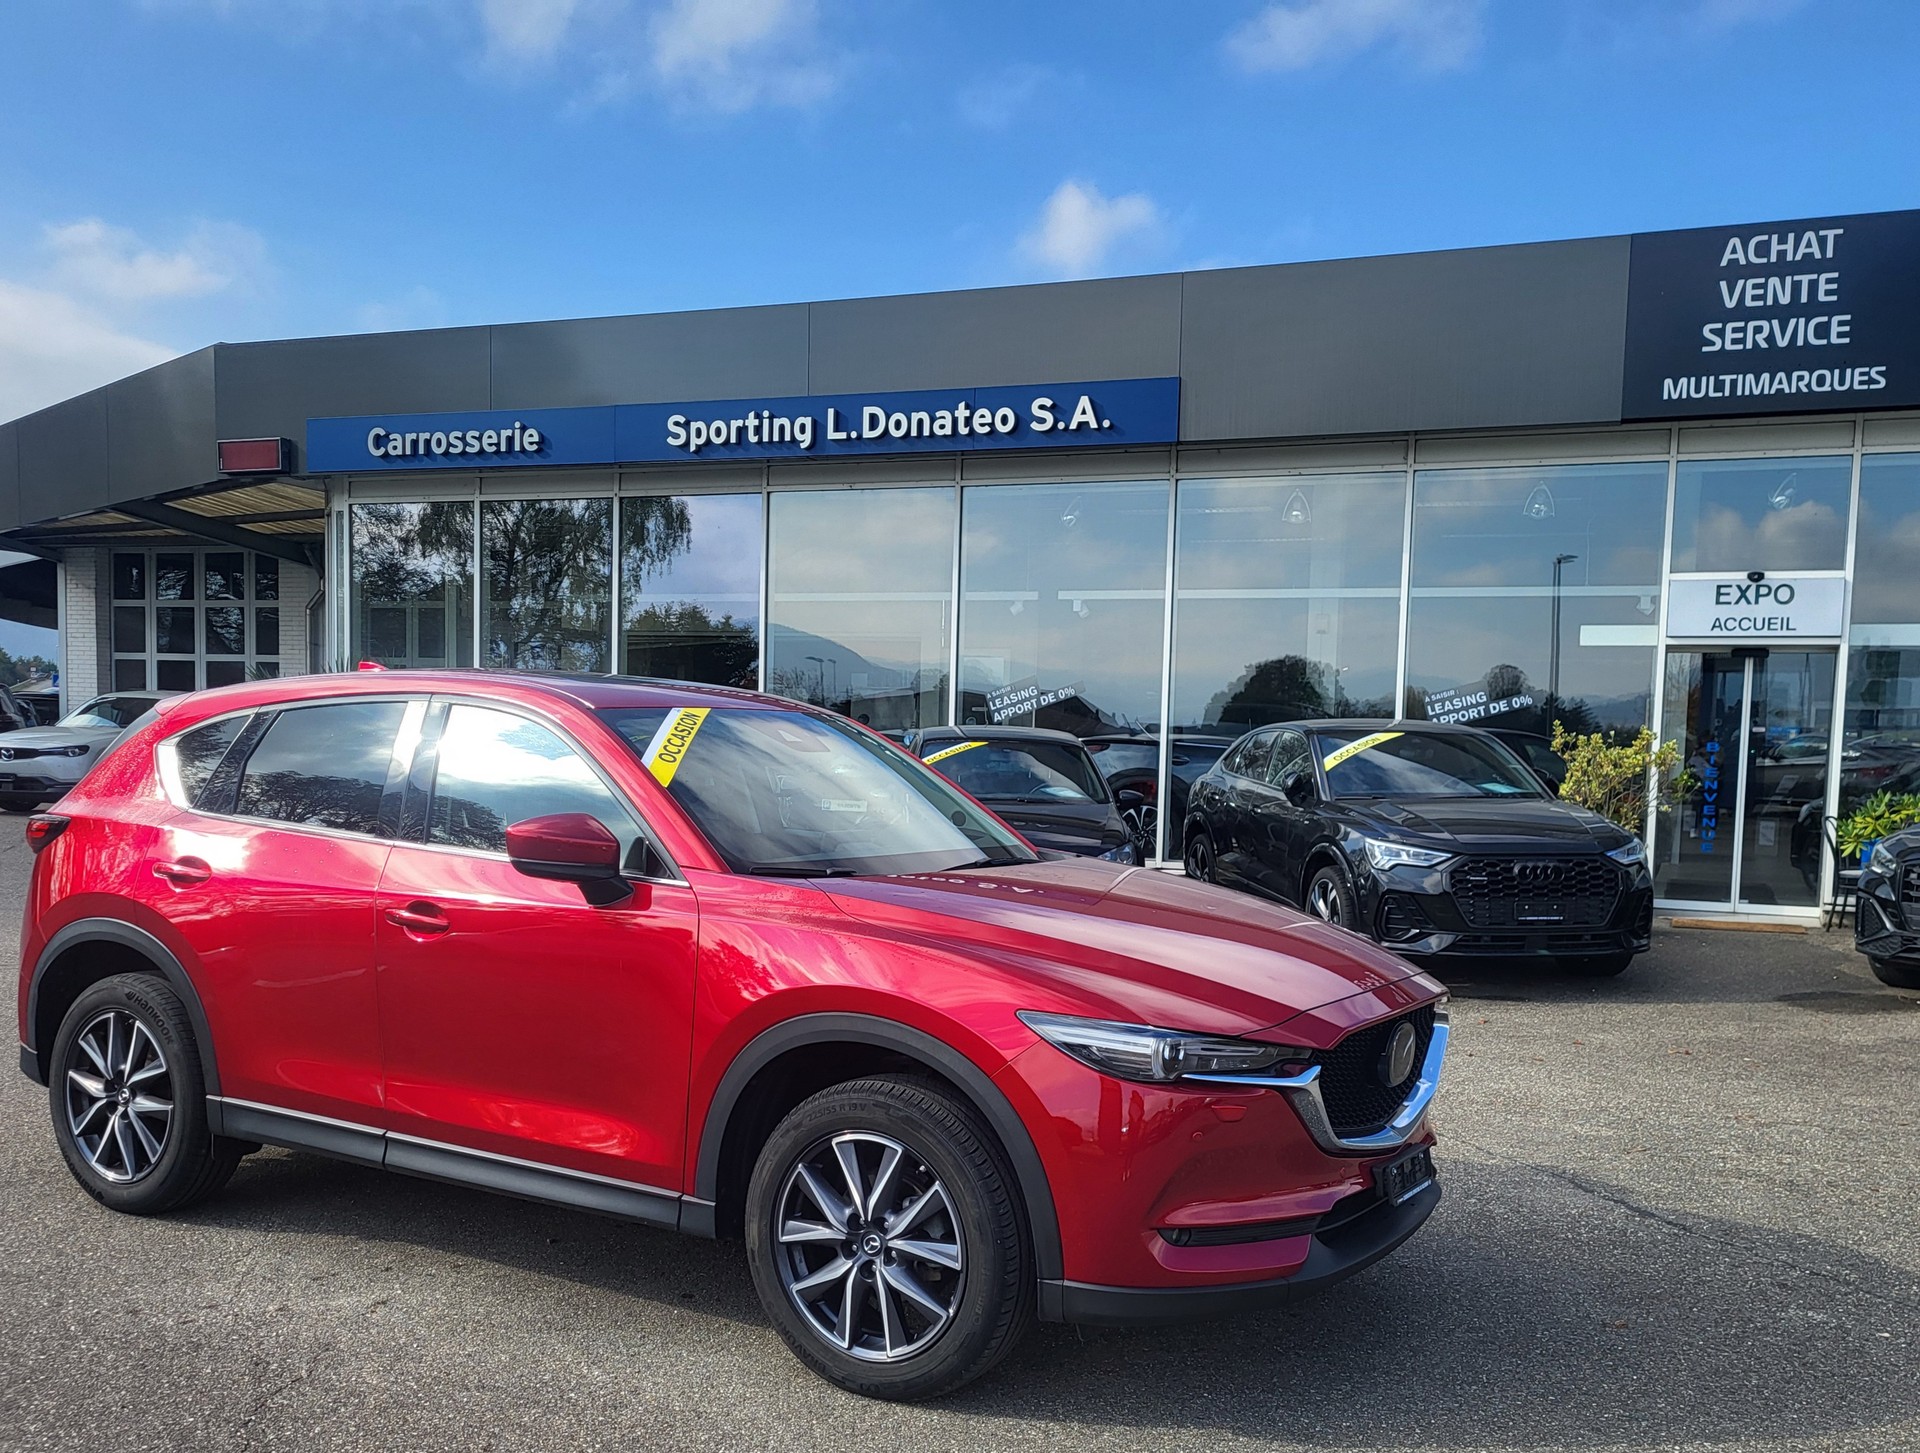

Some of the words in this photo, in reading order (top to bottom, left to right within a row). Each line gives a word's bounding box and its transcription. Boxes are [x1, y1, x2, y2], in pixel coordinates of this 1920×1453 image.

[1720, 228, 1844, 267] ACHAT
[1719, 272, 1839, 309] VENTE
[1701, 314, 1851, 352] SERVICE
[1662, 366, 1887, 400] MULTIMARQUES
[367, 421, 540, 457] Carrosserie
[666, 410, 813, 453] Sporting
[827, 401, 1016, 441] L.Donateo
[1030, 395, 1111, 432] S.A.
[1715, 583, 1796, 606] EXPO
[1710, 616, 1797, 632] ACCUEIL
[990, 686, 1038, 710] LEASING
[994, 699, 1037, 722] APPORT
[1040, 692, 1057, 706] DE
[1058, 686, 1076, 699] 0%
[1427, 691, 1487, 715] LEASING
[1431, 689, 1455, 701] SAISIR
[1489, 699, 1510, 715] DE
[1511, 694, 1533, 708] 0%
[658, 711, 701, 763] OCCASION
[927, 744, 972, 762] OCCASION
[1333, 737, 1381, 761] OCCASION
[1701, 742, 1719, 853] BIENVENUE
